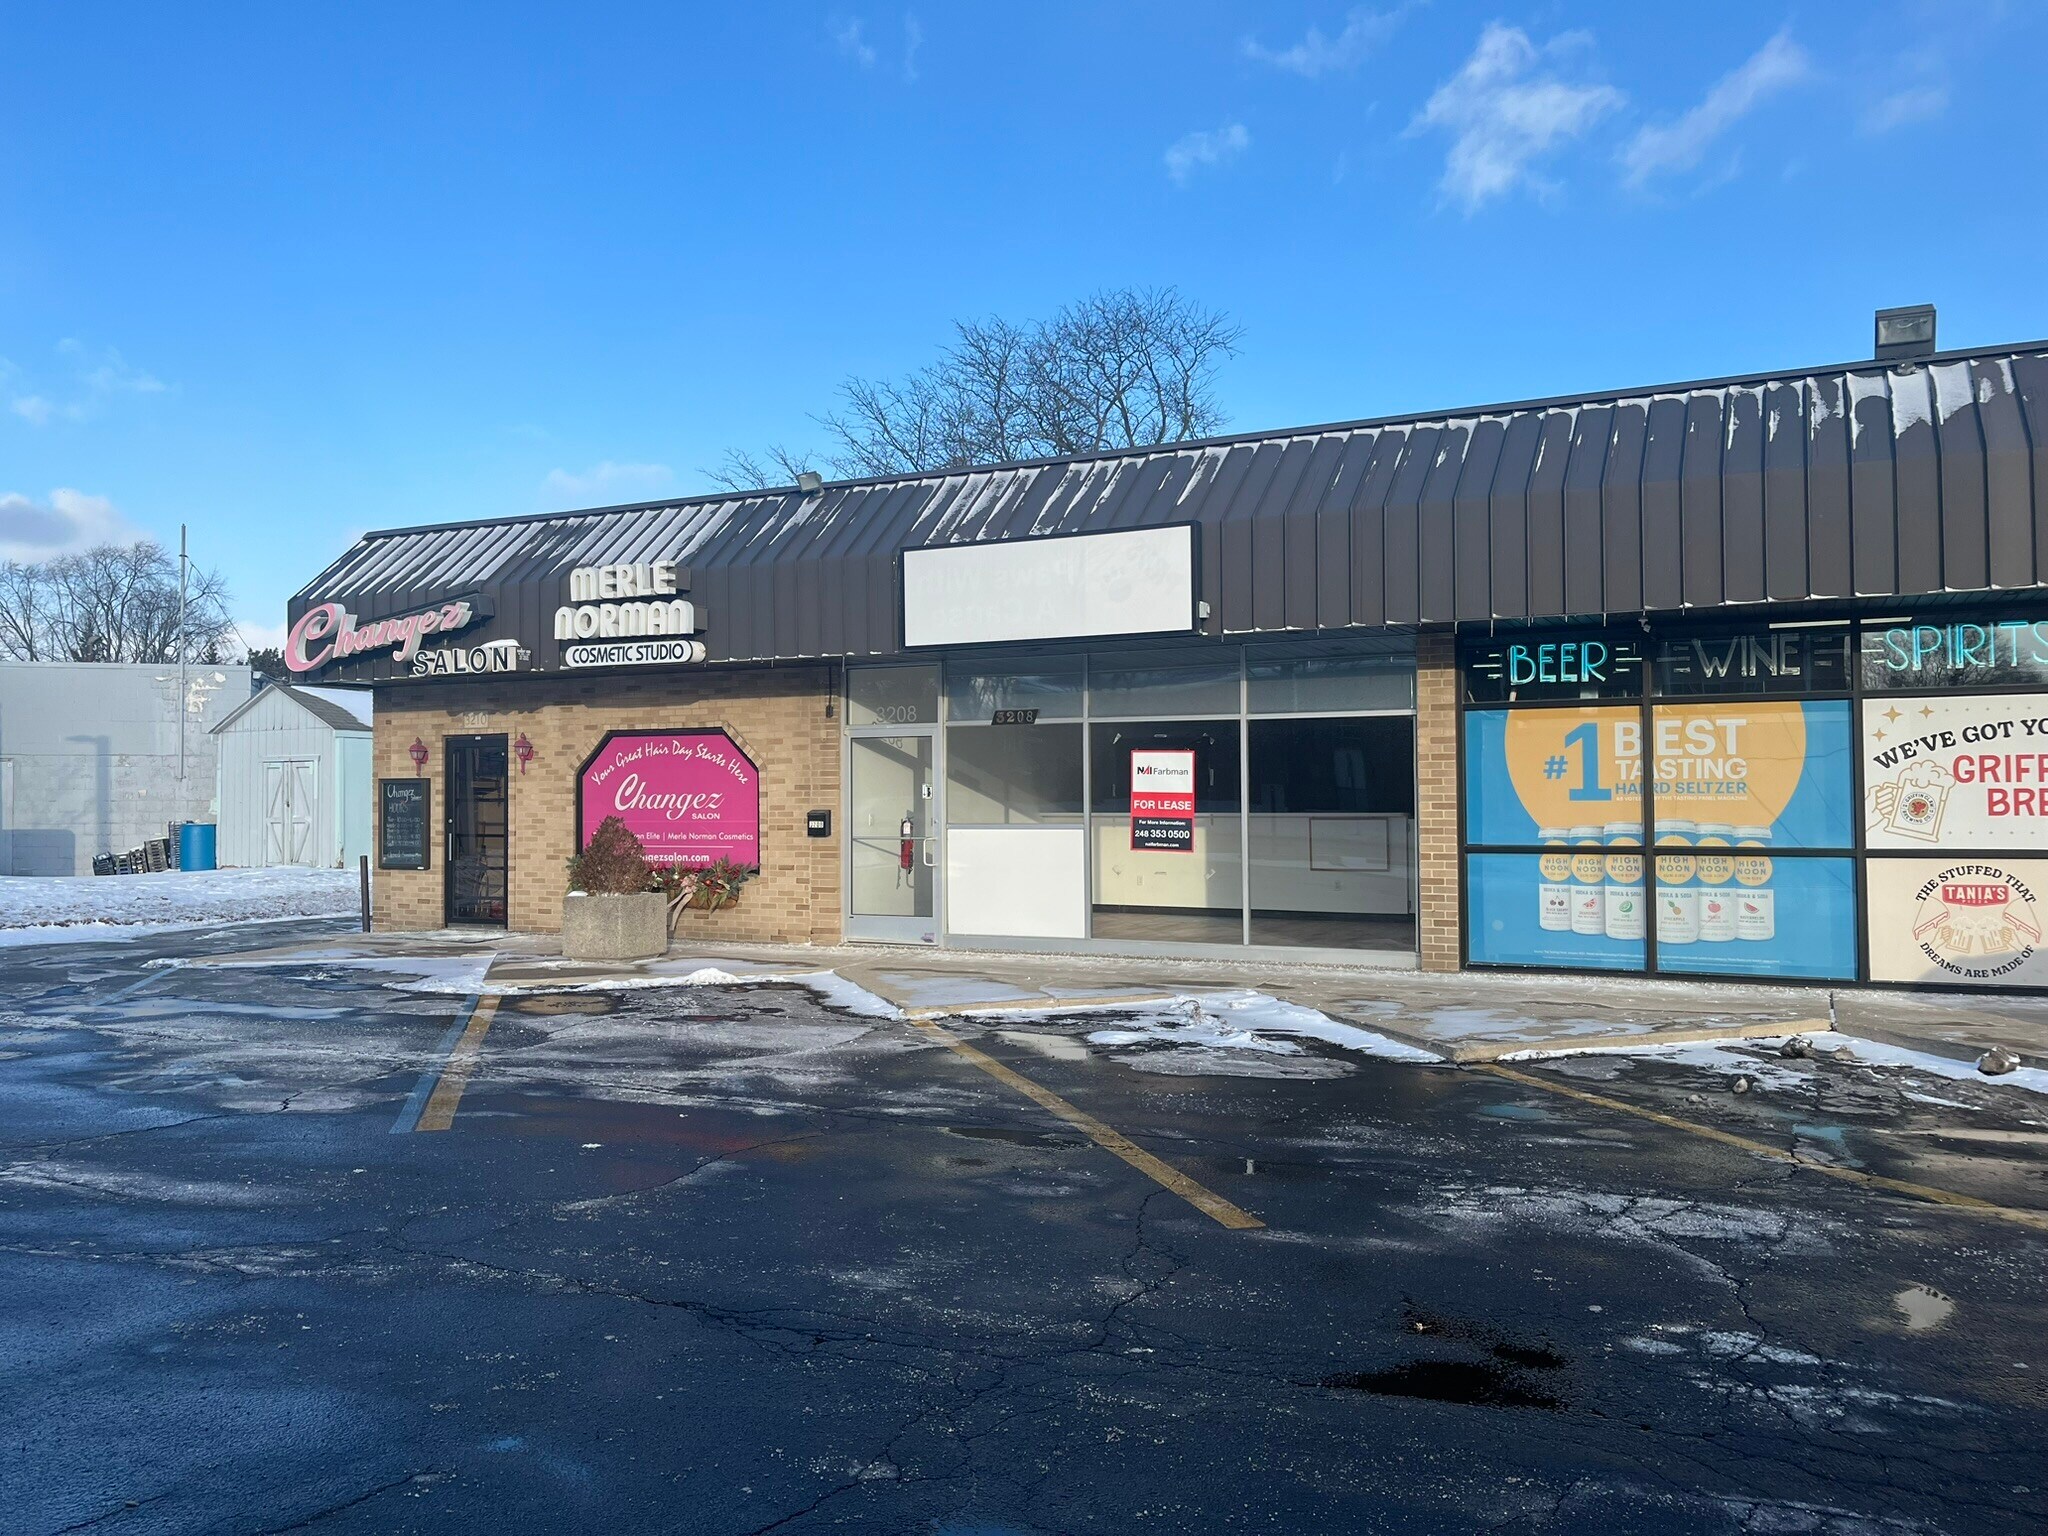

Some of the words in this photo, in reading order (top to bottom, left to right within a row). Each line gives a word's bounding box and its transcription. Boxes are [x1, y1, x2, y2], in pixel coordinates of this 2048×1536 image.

[570, 560, 677, 601] MERLE
[285, 602, 472, 672] Changez
[555, 599, 695, 639] NORMAN
[413, 647, 513, 676] SALON
[572, 645, 633, 663] COSMETIC
[636, 643, 685, 663] STUDIO
[1510, 641, 1607, 686] BEER
[1692, 633, 1801, 678] WINE
[1886, 621, 2048, 671] SPIRITS
[876, 705, 917, 723] 3208
[996, 710, 1034, 723] 3208
[1614, 719, 1747, 757] BEST
[1873, 731, 1957, 770] WE'VE
[1962, 721, 2014, 744] GOT
[591, 765, 615, 786] Your
[615, 747, 643, 767] Great
[645, 741, 669, 757] Hair
[672, 740, 694, 760] Day
[695, 743, 726, 767] Starts
[728, 759, 749, 785] Here
[1543, 722, 1612, 801] #1
[1614, 758, 1748, 780] TASTING
[614, 773, 725, 820] Changez
[1134, 800, 1155, 809] FOR
[1158, 801, 1192, 810] LEASE
[1675, 782, 1747, 794] SELTZER
[646, 832, 660, 840] Elite
[668, 832, 687, 840] Merle
[689, 832, 717, 840] Norman
[718, 832, 753, 840] Cosmetics
[1134, 830, 1149, 838] 248
[1150, 829, 1167, 838] 353
[1167, 830, 1190, 839] 0500
[1915, 879, 1939, 902] THE
[1938, 865, 2003, 883] STUFFED
[2005, 873, 2036, 904] THAT
[1945, 887, 2006, 900] TANIA'S
[1920, 942, 1963, 975] DREAMS
[1964, 968, 1990, 978] ARE
[1991, 957, 2023, 977] MADE
[2021, 944, 2035, 959] OF
